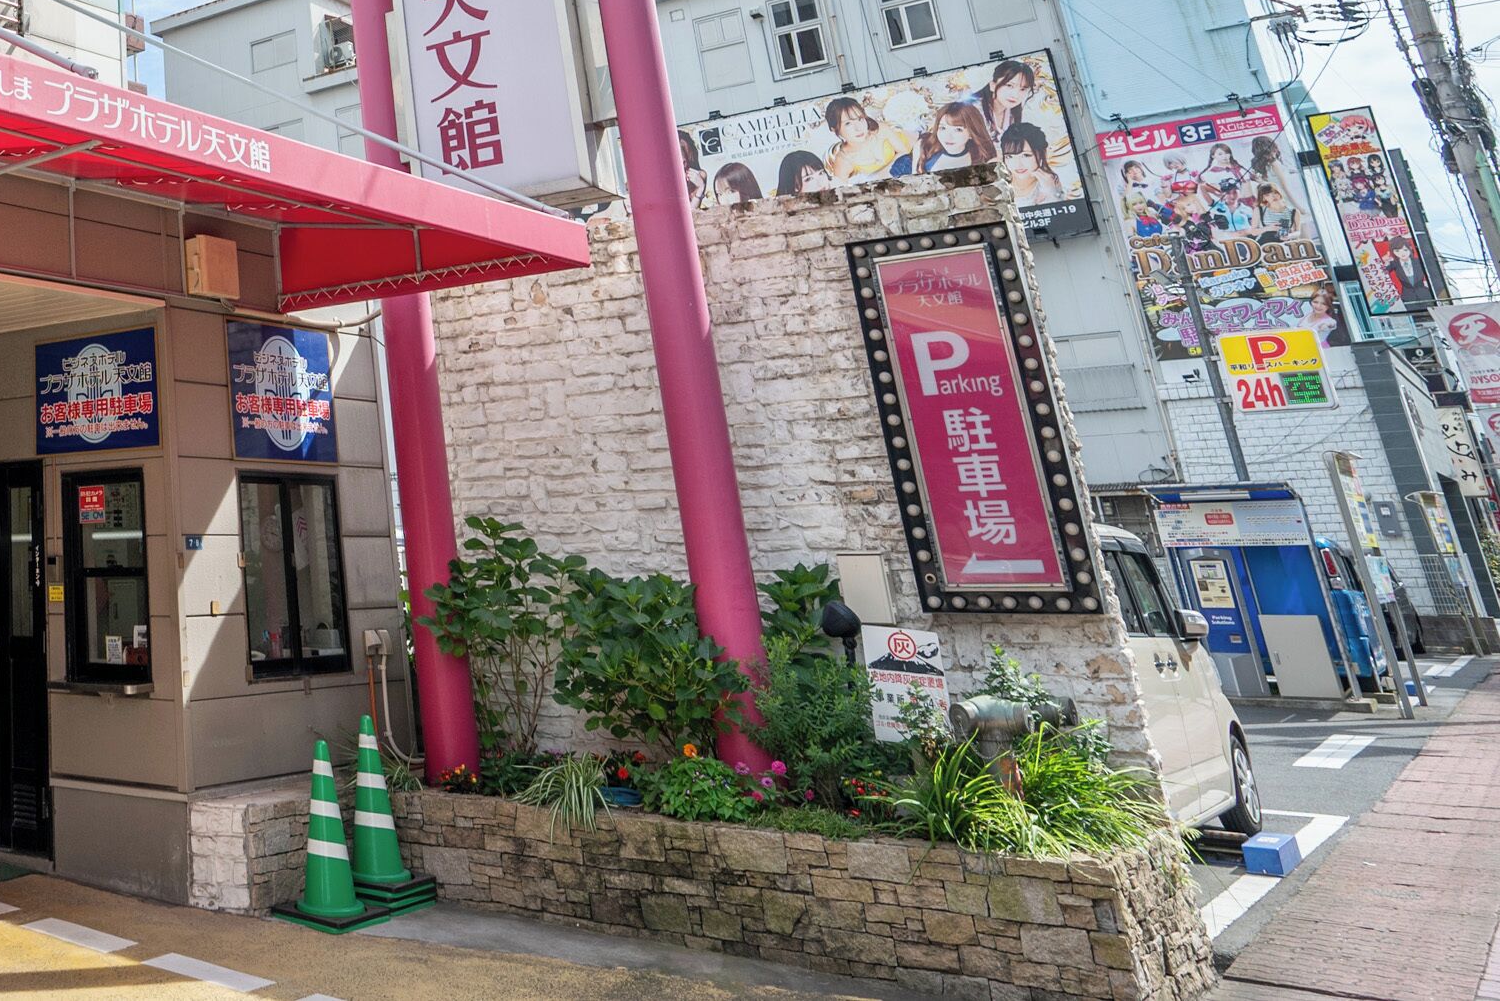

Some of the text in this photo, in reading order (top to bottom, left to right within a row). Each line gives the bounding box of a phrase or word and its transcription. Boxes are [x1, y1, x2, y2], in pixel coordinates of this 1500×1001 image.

[44, 79, 272, 174] プラザホテル天文館
[722, 107, 821, 138] CAMELLIA
[739, 125, 806, 150] GROUP
[1103, 124, 1211, 156] 当ビル 3F
[893, 273, 983, 295] プラザホテル
[917, 291, 964, 308] 天文館
[61, 350, 127, 372] ビジネスホテル
[1246, 335, 1288, 372] P
[39, 361, 153, 394] プラザホテル天文館
[1236, 377, 1287, 409] 24h
[40, 391, 154, 424] お客様専用駐車場
[235, 391, 331, 421] お客様専用駐車場
[941, 406, 1017, 546] 駐車場
[893, 638, 911, 655] 灰
